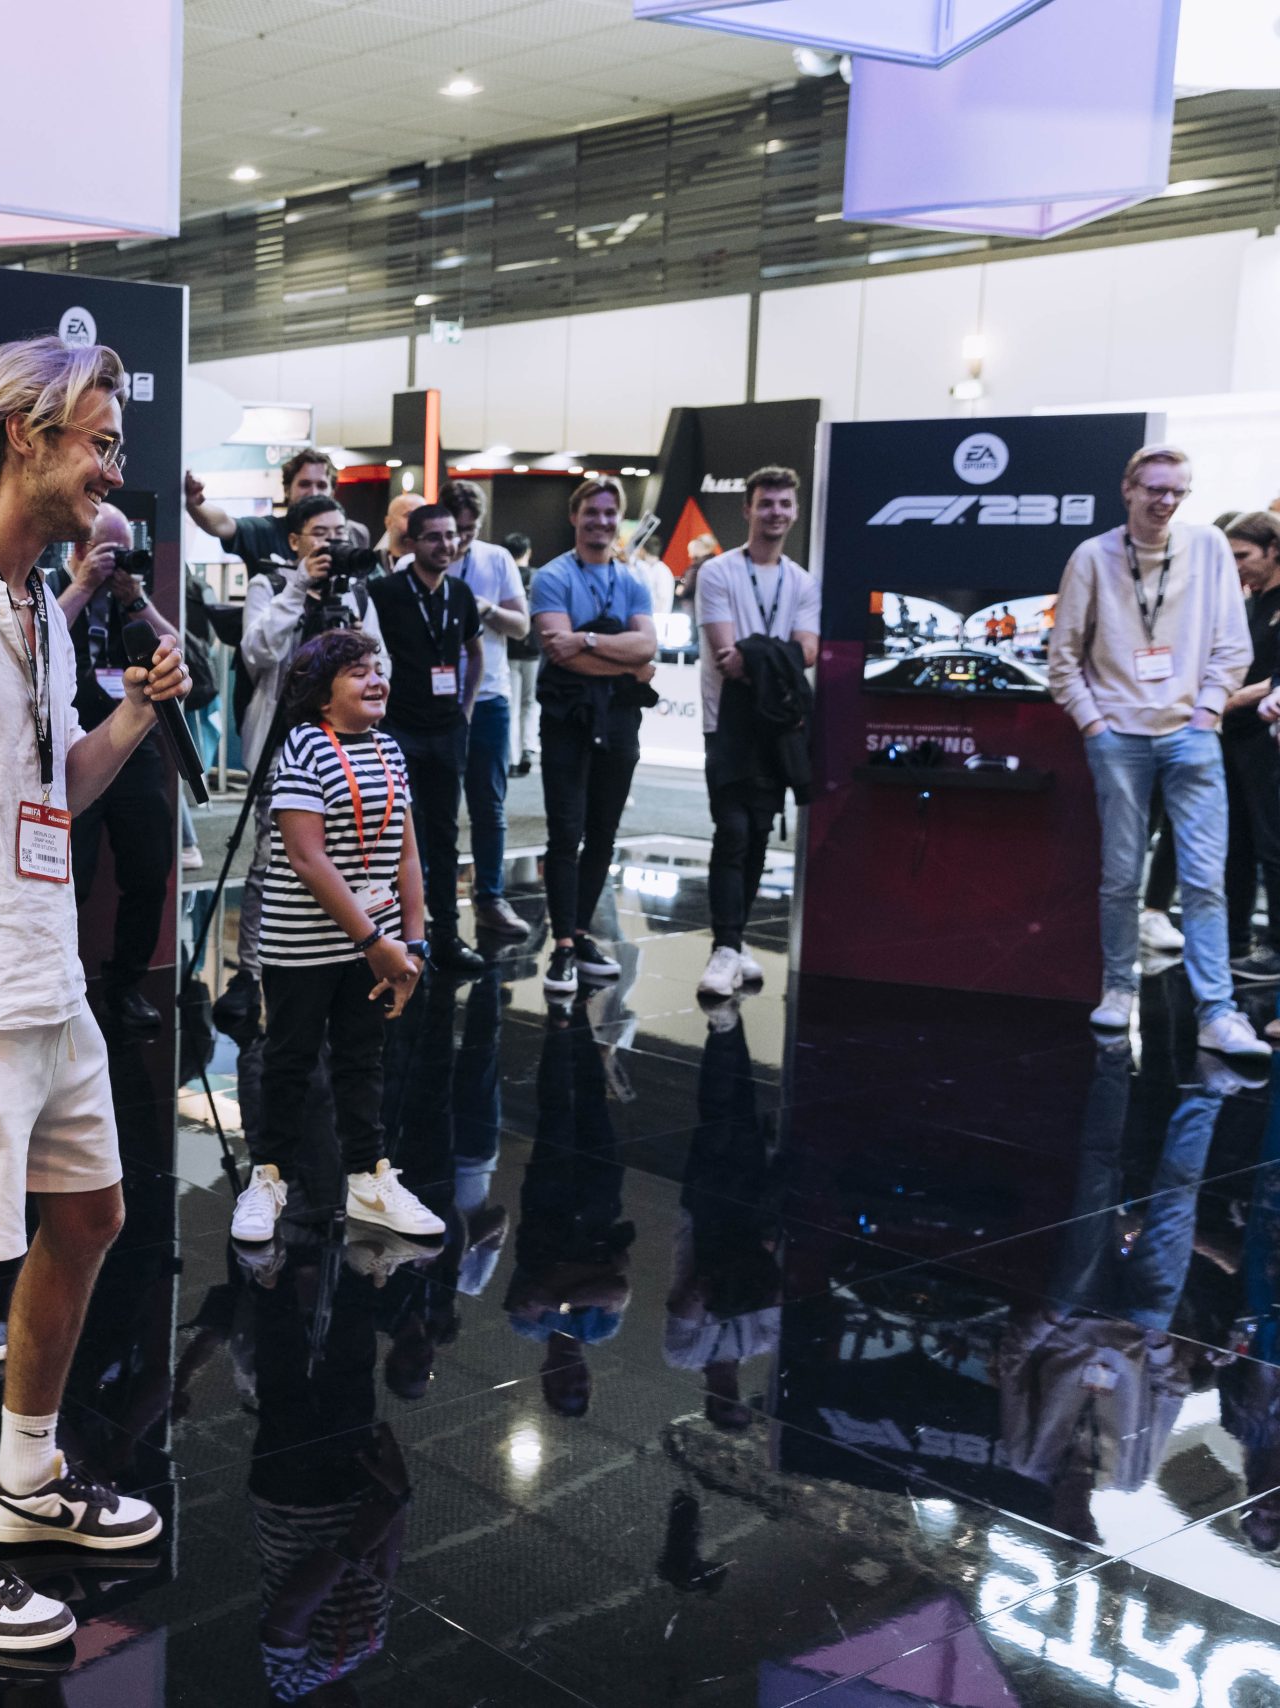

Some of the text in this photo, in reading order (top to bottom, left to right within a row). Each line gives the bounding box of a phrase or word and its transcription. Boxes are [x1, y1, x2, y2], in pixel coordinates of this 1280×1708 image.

[67, 318, 88, 334] EA
[965, 445, 997, 462] EA
[978, 494, 1059, 525] 23
[30, 573, 48, 623] Hisense
[866, 734, 976, 754] SAMSNG
